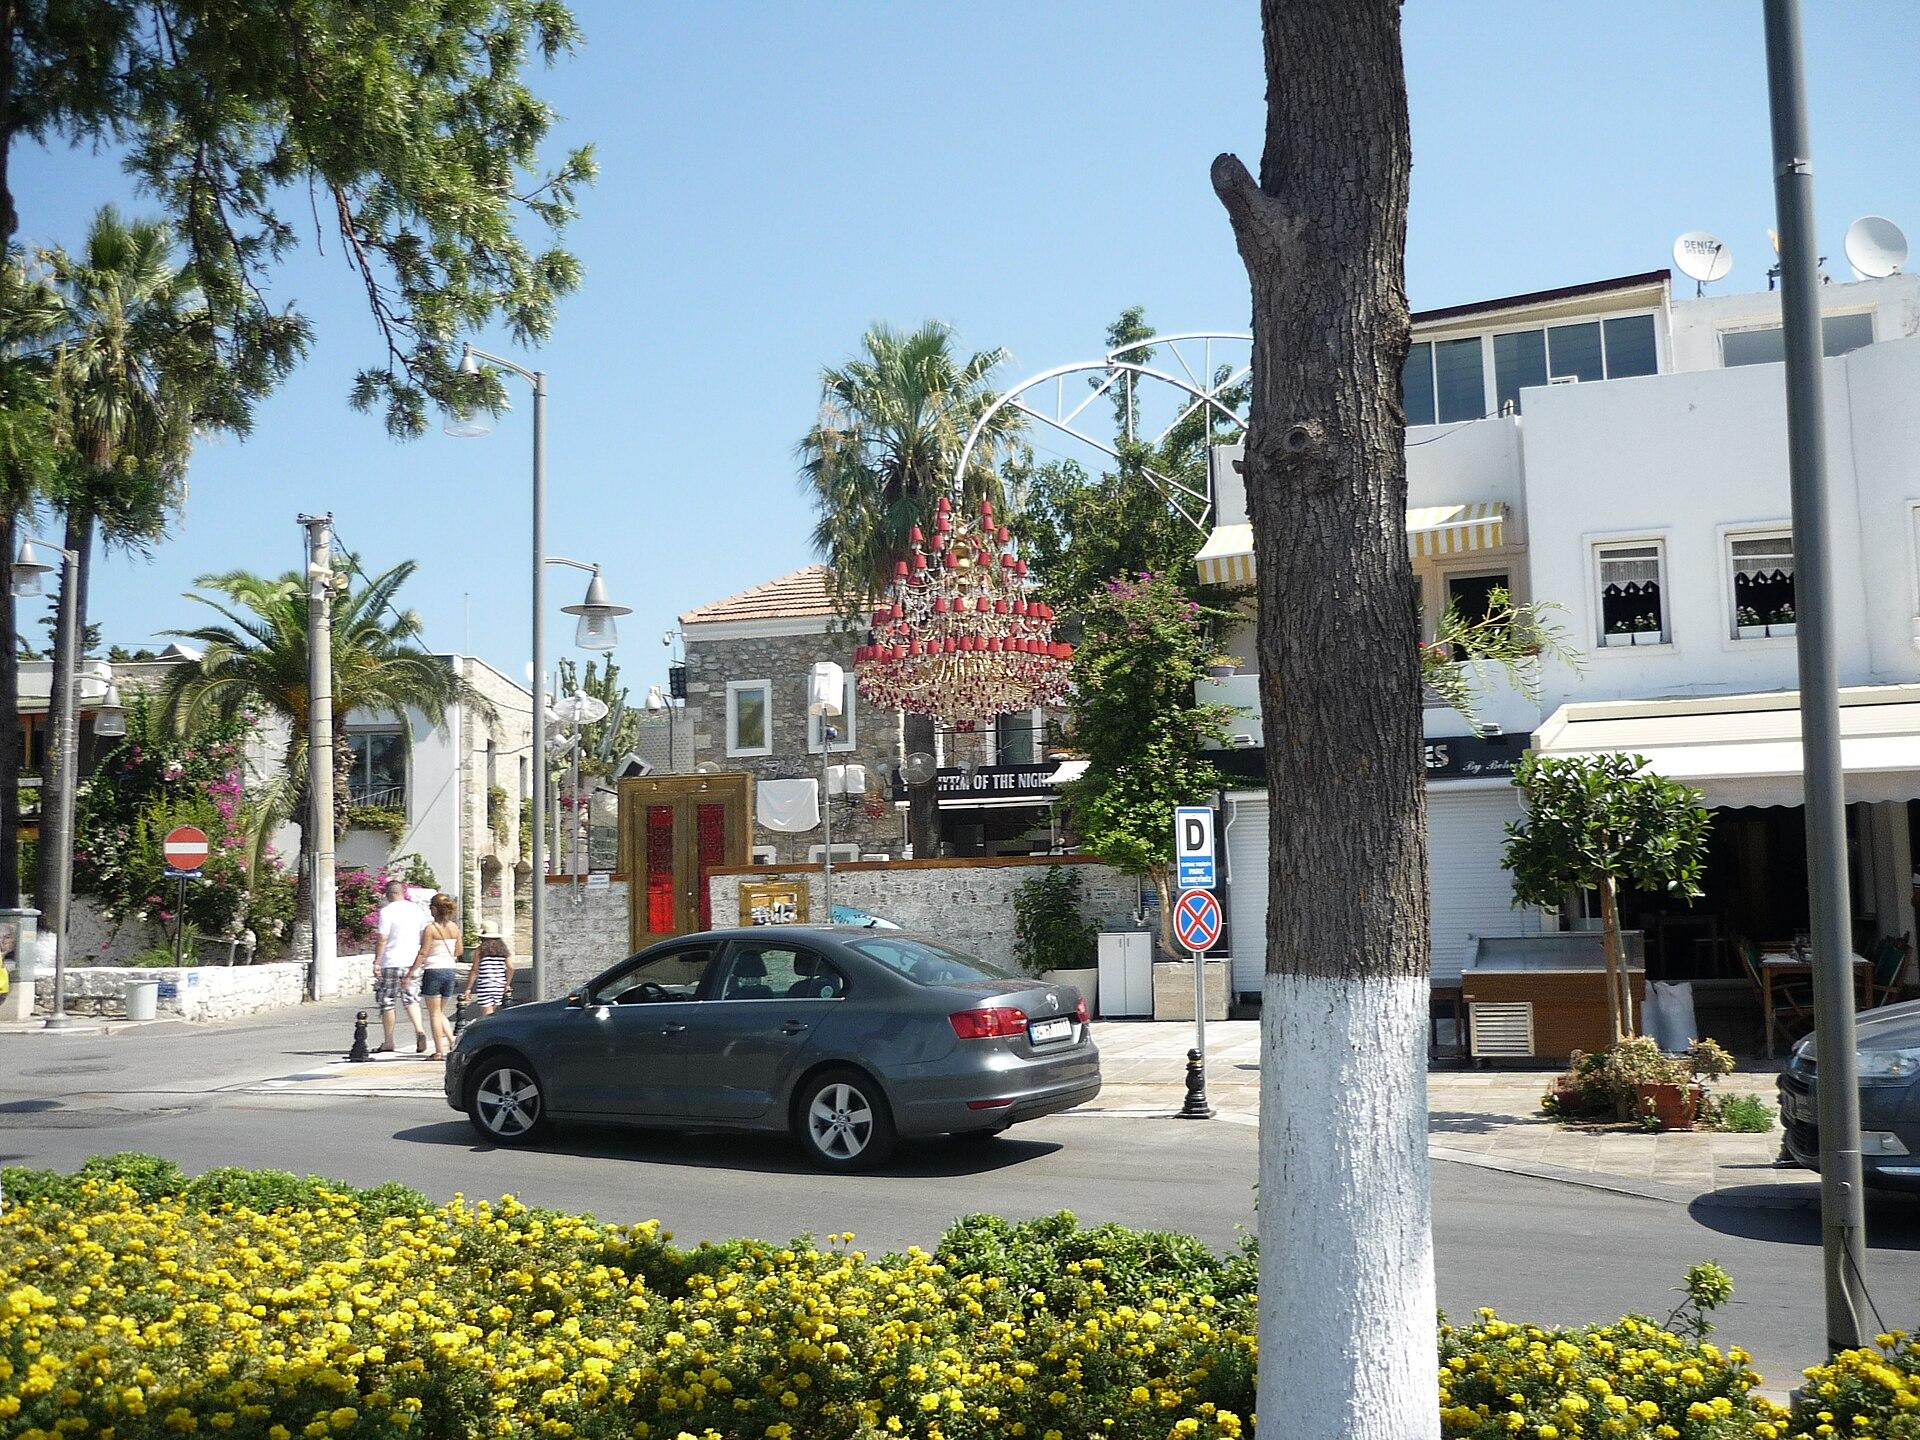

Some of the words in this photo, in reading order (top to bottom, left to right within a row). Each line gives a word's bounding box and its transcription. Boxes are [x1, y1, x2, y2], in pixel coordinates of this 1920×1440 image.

[973, 774, 989, 790] OF
[992, 773, 1015, 789] THE
[1018, 772, 1053, 788] NIGHT
[1185, 818, 1205, 851] D
